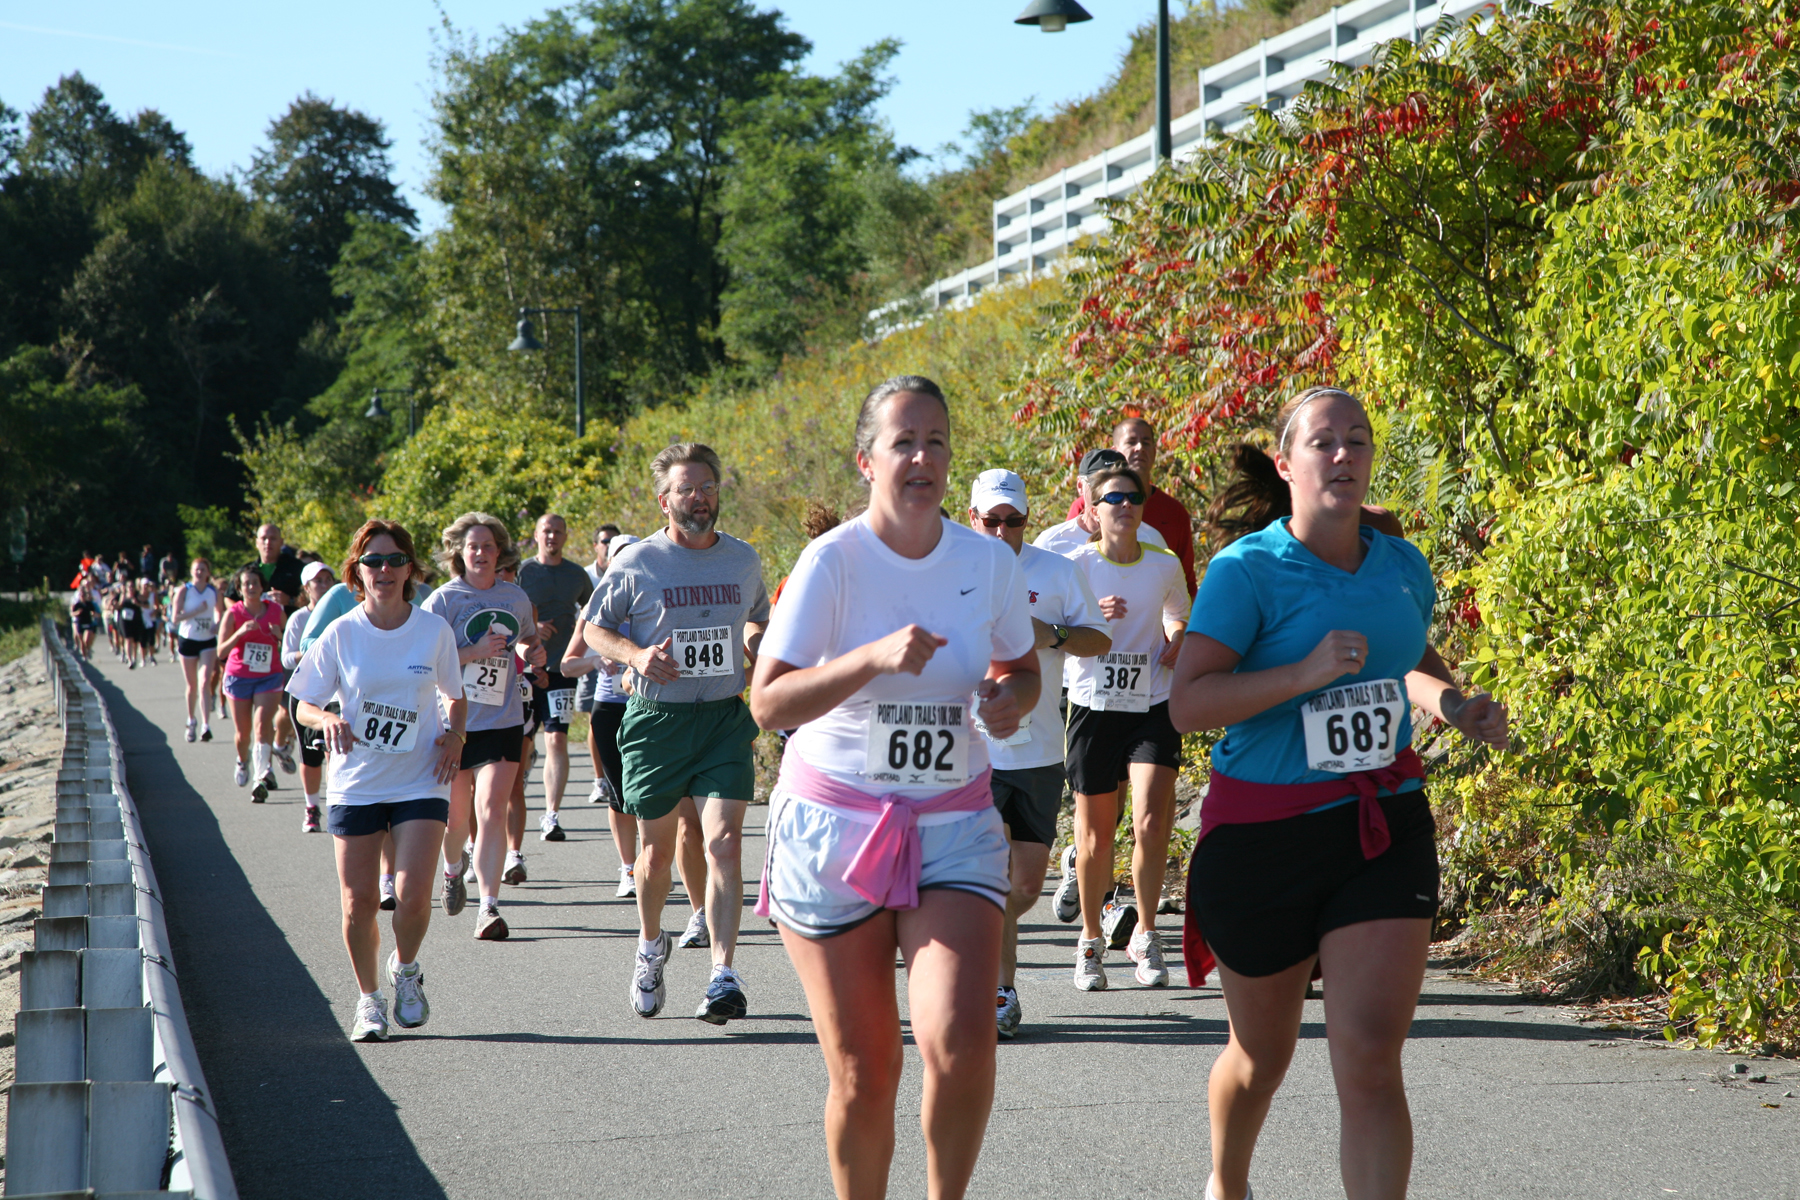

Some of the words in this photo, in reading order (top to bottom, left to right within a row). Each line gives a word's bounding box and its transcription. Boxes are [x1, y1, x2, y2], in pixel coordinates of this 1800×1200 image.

[662, 584, 741, 608] RUNNING
[676, 630, 697, 643] PORTLAND
[697, 629, 711, 642] TRAILS
[711, 628, 719, 641] 10K
[719, 627, 729, 640] 2009
[249, 649, 268, 663] 765
[684, 643, 724, 669] 848
[1118, 654, 1131, 665] TRAILS
[1139, 654, 1148, 666] 2009
[477, 667, 498, 687] 25
[1103, 666, 1141, 690] 387
[555, 697, 574, 711] 675
[1308, 690, 1345, 713] PORTLAND
[1344, 684, 1371, 708] TRAILS
[1371, 683, 1385, 704] 10K
[362, 701, 385, 717] PORTLAND
[384, 705, 399, 720] TRAILS
[399, 709, 408, 722] 10K
[406, 710, 418, 724] 2009
[877, 703, 913, 725] PORTLAND
[914, 705, 937, 726] TRAILS
[937, 706, 948, 726] 10K
[948, 706, 963, 726] 2009
[364, 717, 408, 747] 847
[1326, 707, 1391, 756] 683
[888, 729, 954, 771] 682
